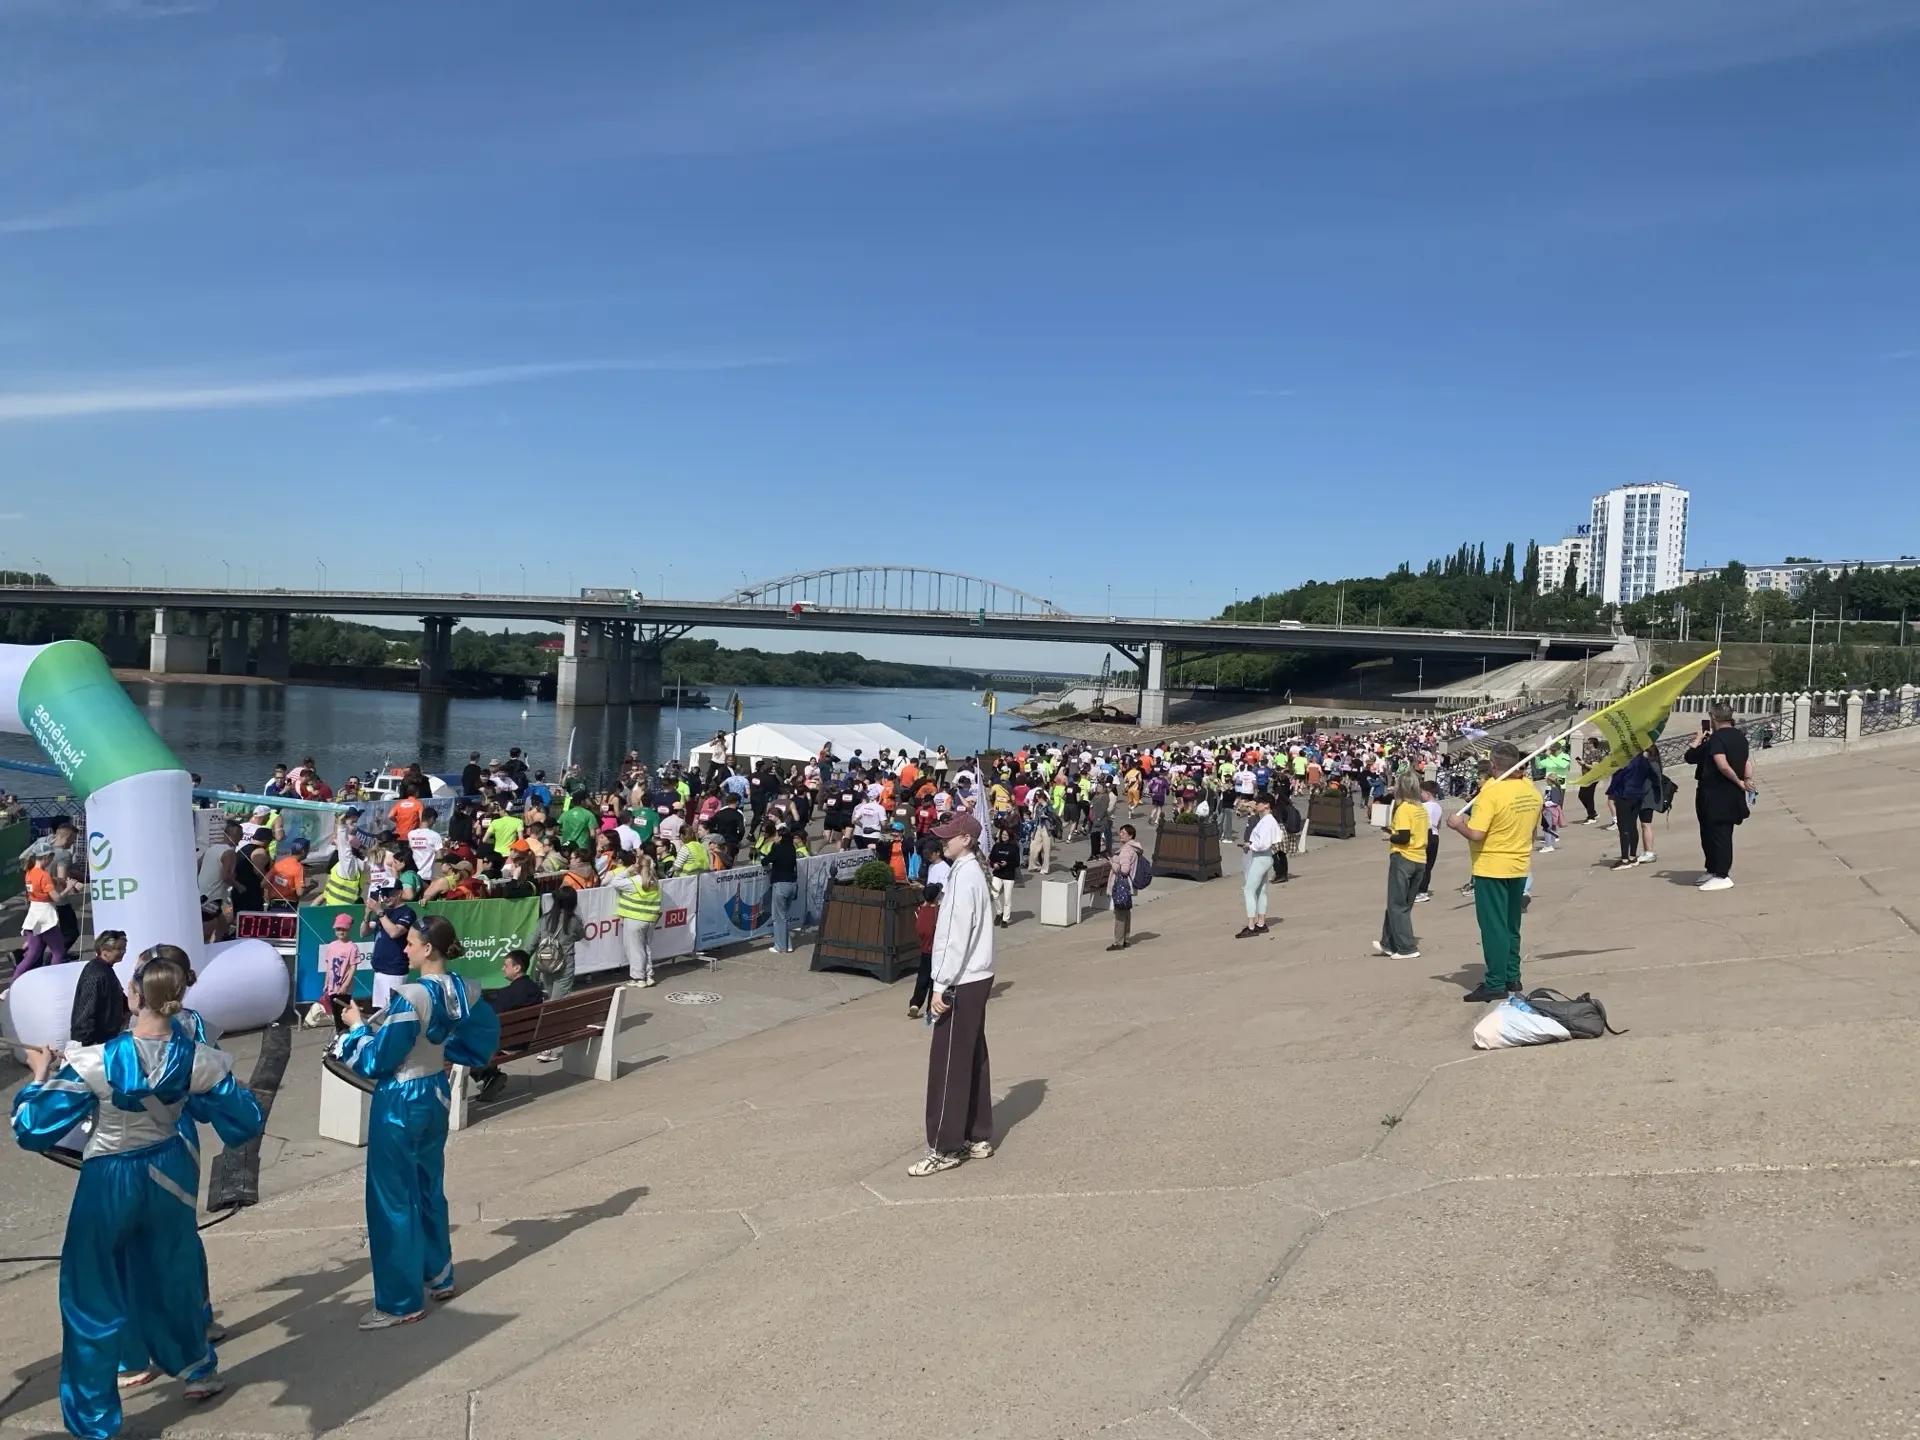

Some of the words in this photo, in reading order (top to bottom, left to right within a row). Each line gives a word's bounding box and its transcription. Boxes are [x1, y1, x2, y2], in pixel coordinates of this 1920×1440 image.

[30, 717, 74, 781] марафон
[35, 704, 87, 768] зелёный
[91, 878, 138, 901] БЕР
[583, 918, 622, 941] ОРТ
